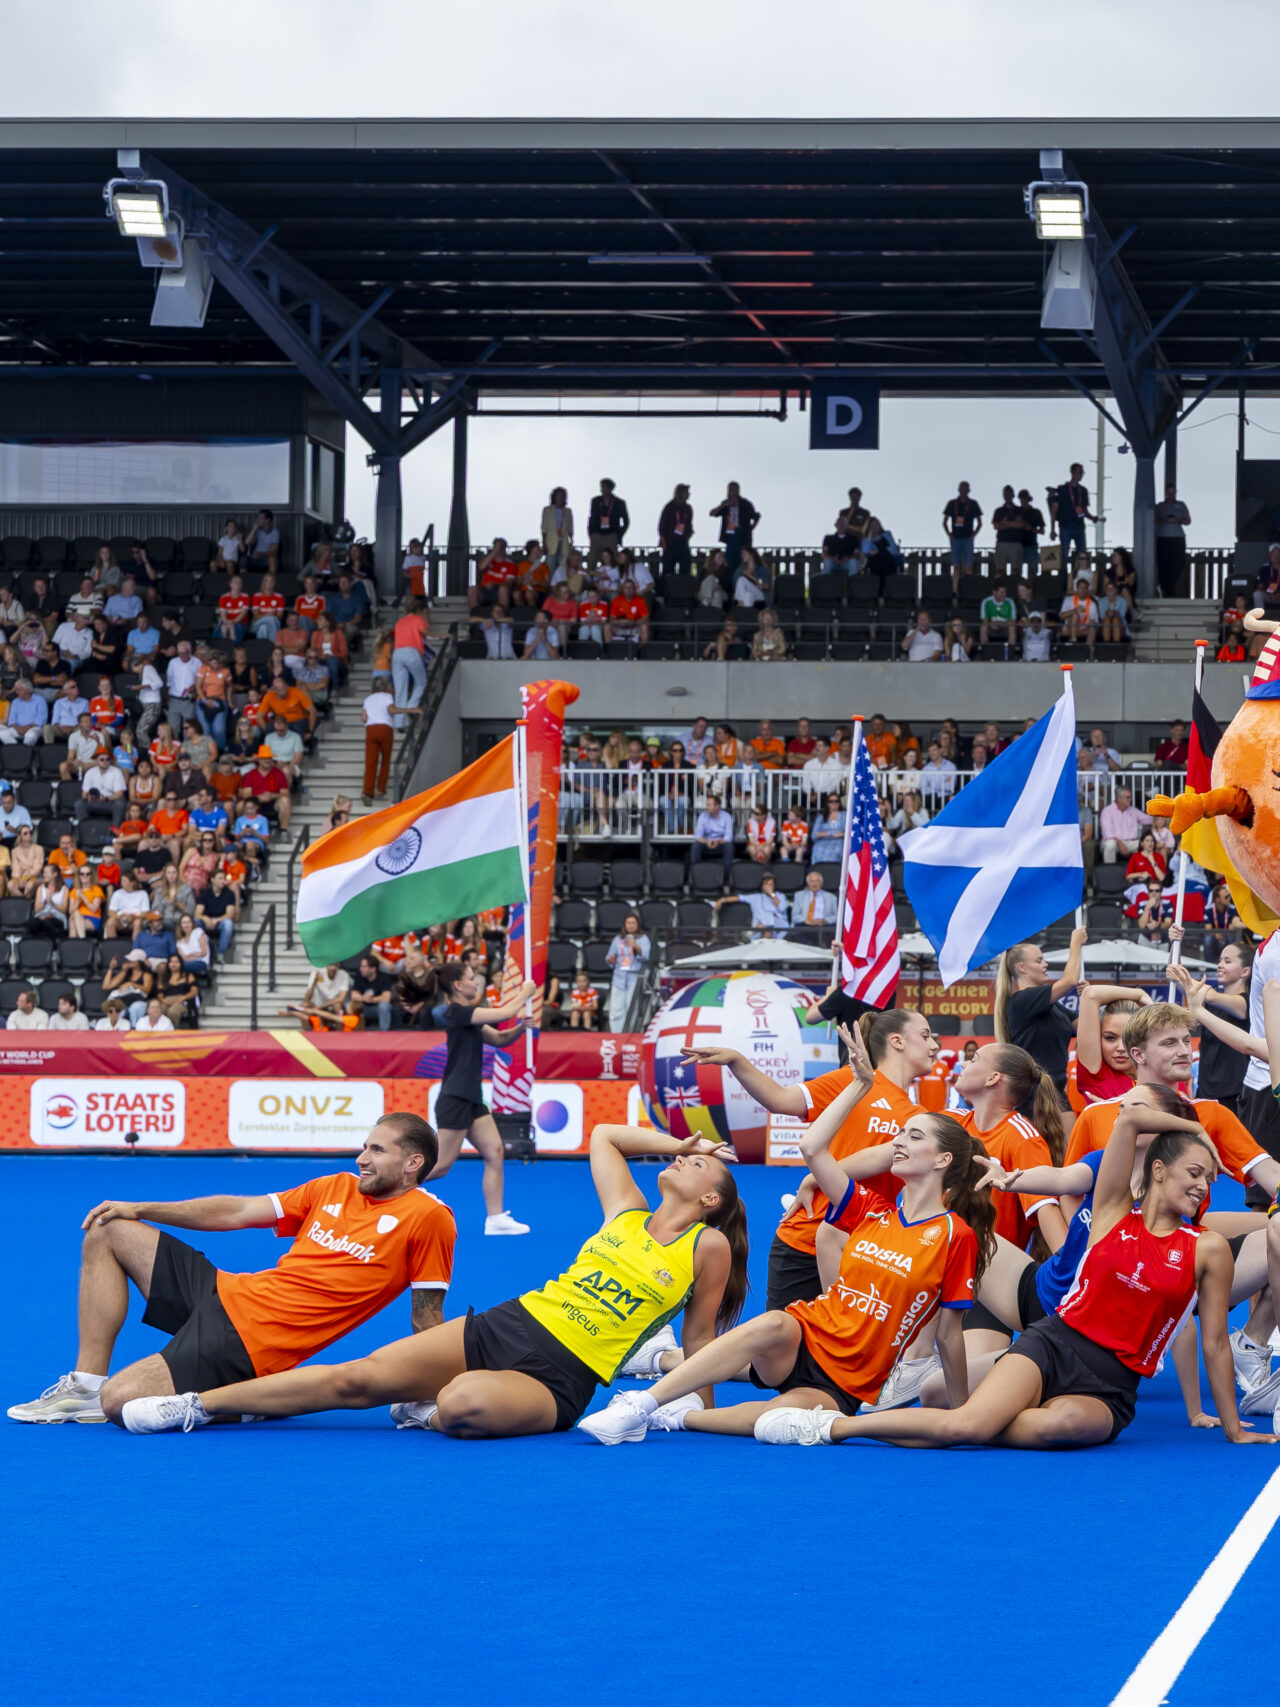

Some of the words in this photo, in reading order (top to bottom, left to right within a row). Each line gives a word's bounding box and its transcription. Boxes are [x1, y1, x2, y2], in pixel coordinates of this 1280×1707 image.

[826, 396, 863, 434] D
[939, 1002, 990, 1014] GLORY
[749, 1058, 788, 1067] OCKEY
[777, 1069, 800, 1079] CUP
[86, 1093, 175, 1111] STAATS
[258, 1095, 353, 1116] ONVZ
[85, 1114, 175, 1132] LOTERIJ
[855, 1240, 912, 1272] ODISHA
[579, 1270, 645, 1316] APM
[561, 1300, 601, 1336] ingeus
[891, 1291, 928, 1346] ODISHA
